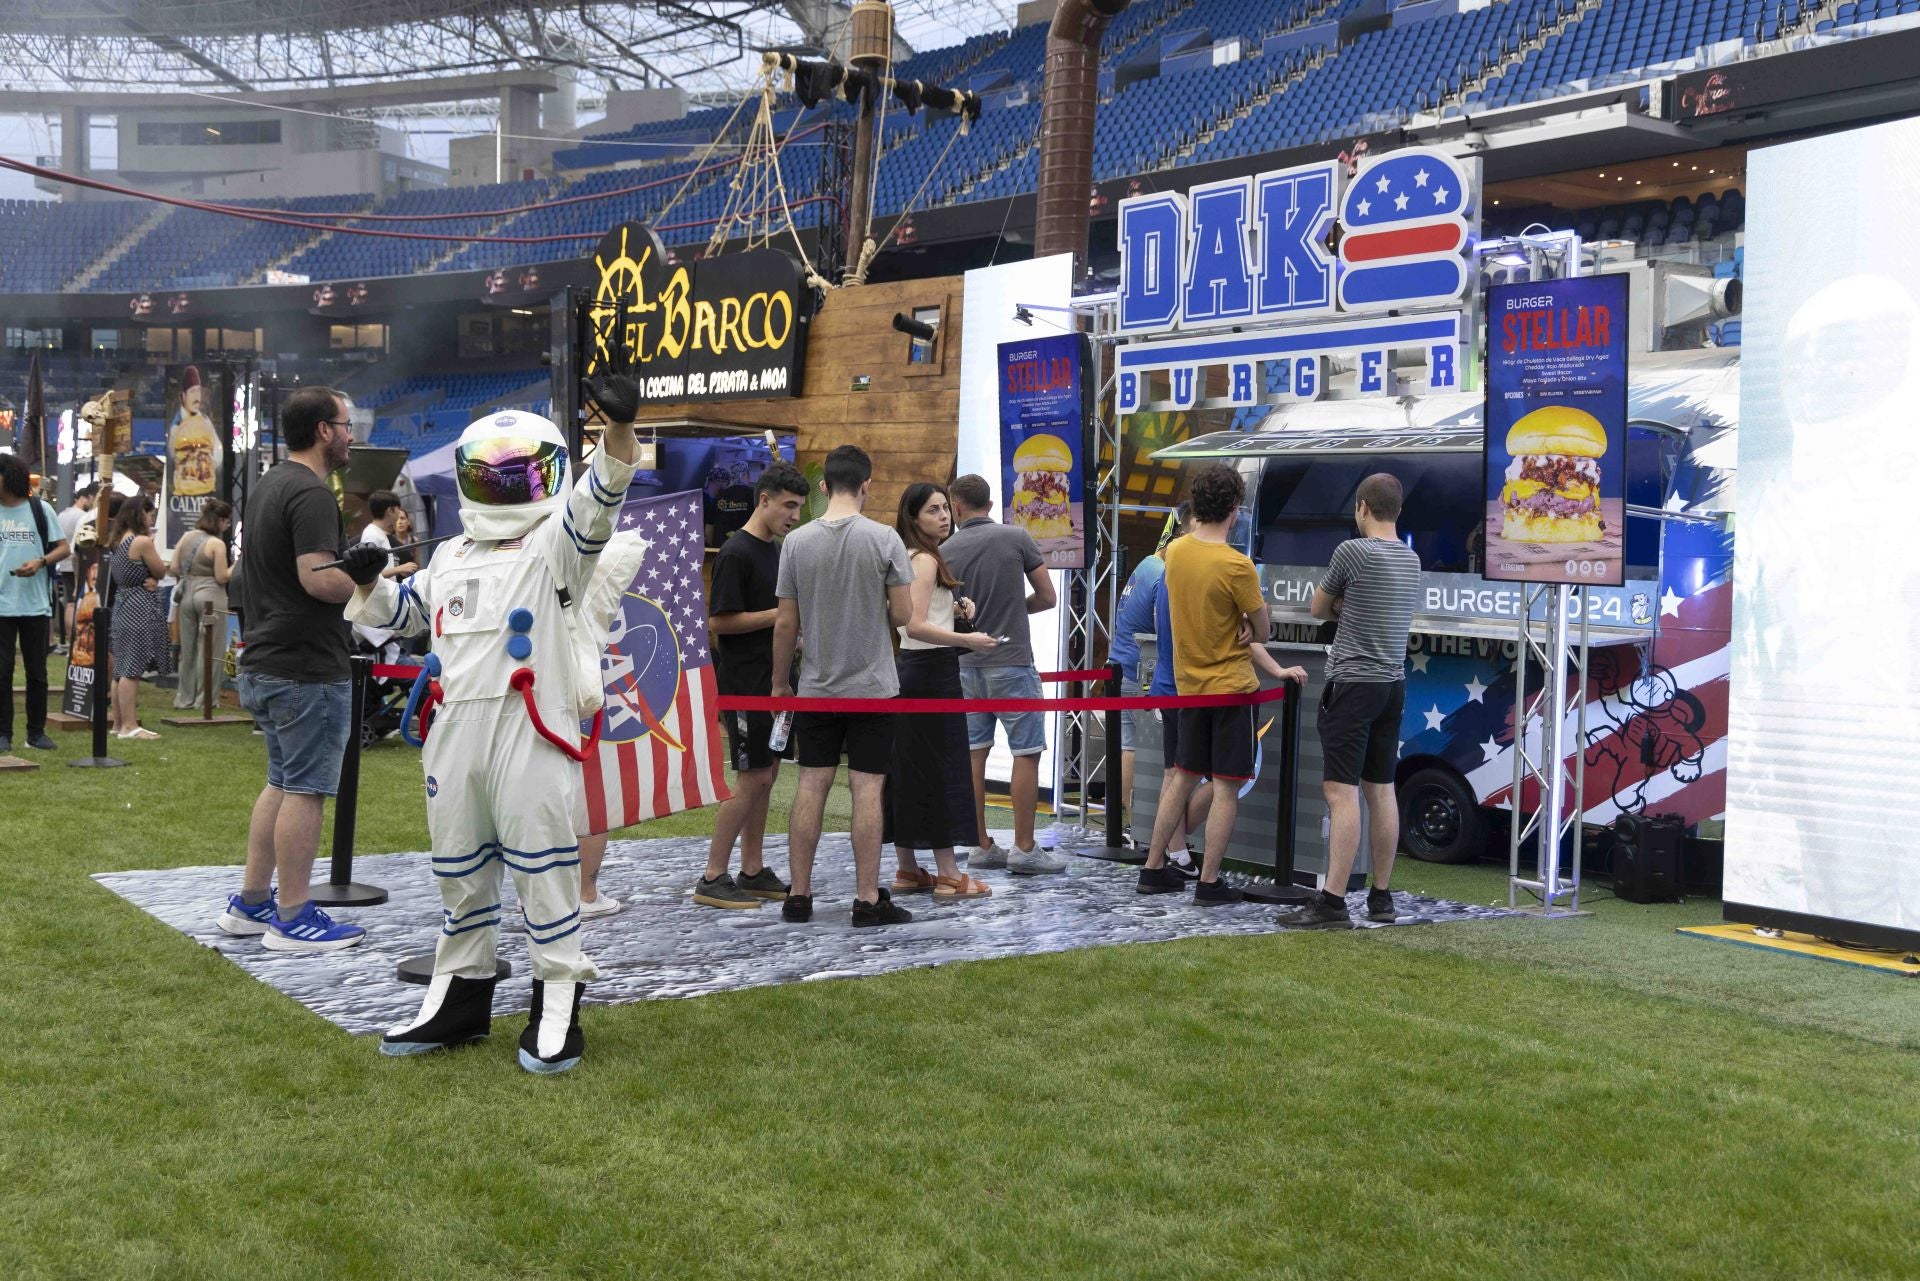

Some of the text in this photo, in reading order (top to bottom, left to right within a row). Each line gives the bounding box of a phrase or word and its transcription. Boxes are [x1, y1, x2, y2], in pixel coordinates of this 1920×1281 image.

[1118, 163, 1335, 331] DAK
[656, 266, 793, 359] BARCO
[1506, 295, 1554, 309] BURGER
[1503, 305, 1610, 354] STELLAR
[1009, 350, 1038, 361] BURGER
[646, 374, 684, 399] COCINA
[687, 372, 707, 395] DEL
[709, 369, 748, 394] PIRATA
[749, 374, 759, 391] &
[760, 366, 788, 391] MOA
[1007, 357, 1072, 396] STELLAR
[1119, 344, 1456, 409] BURGER
[0, 531, 36, 541] URFER
[1273, 580, 1316, 602] CHA
[1545, 592, 1622, 620] 024
[1426, 634, 1472, 656] THE
[68, 664, 95, 685] CALYPSO
